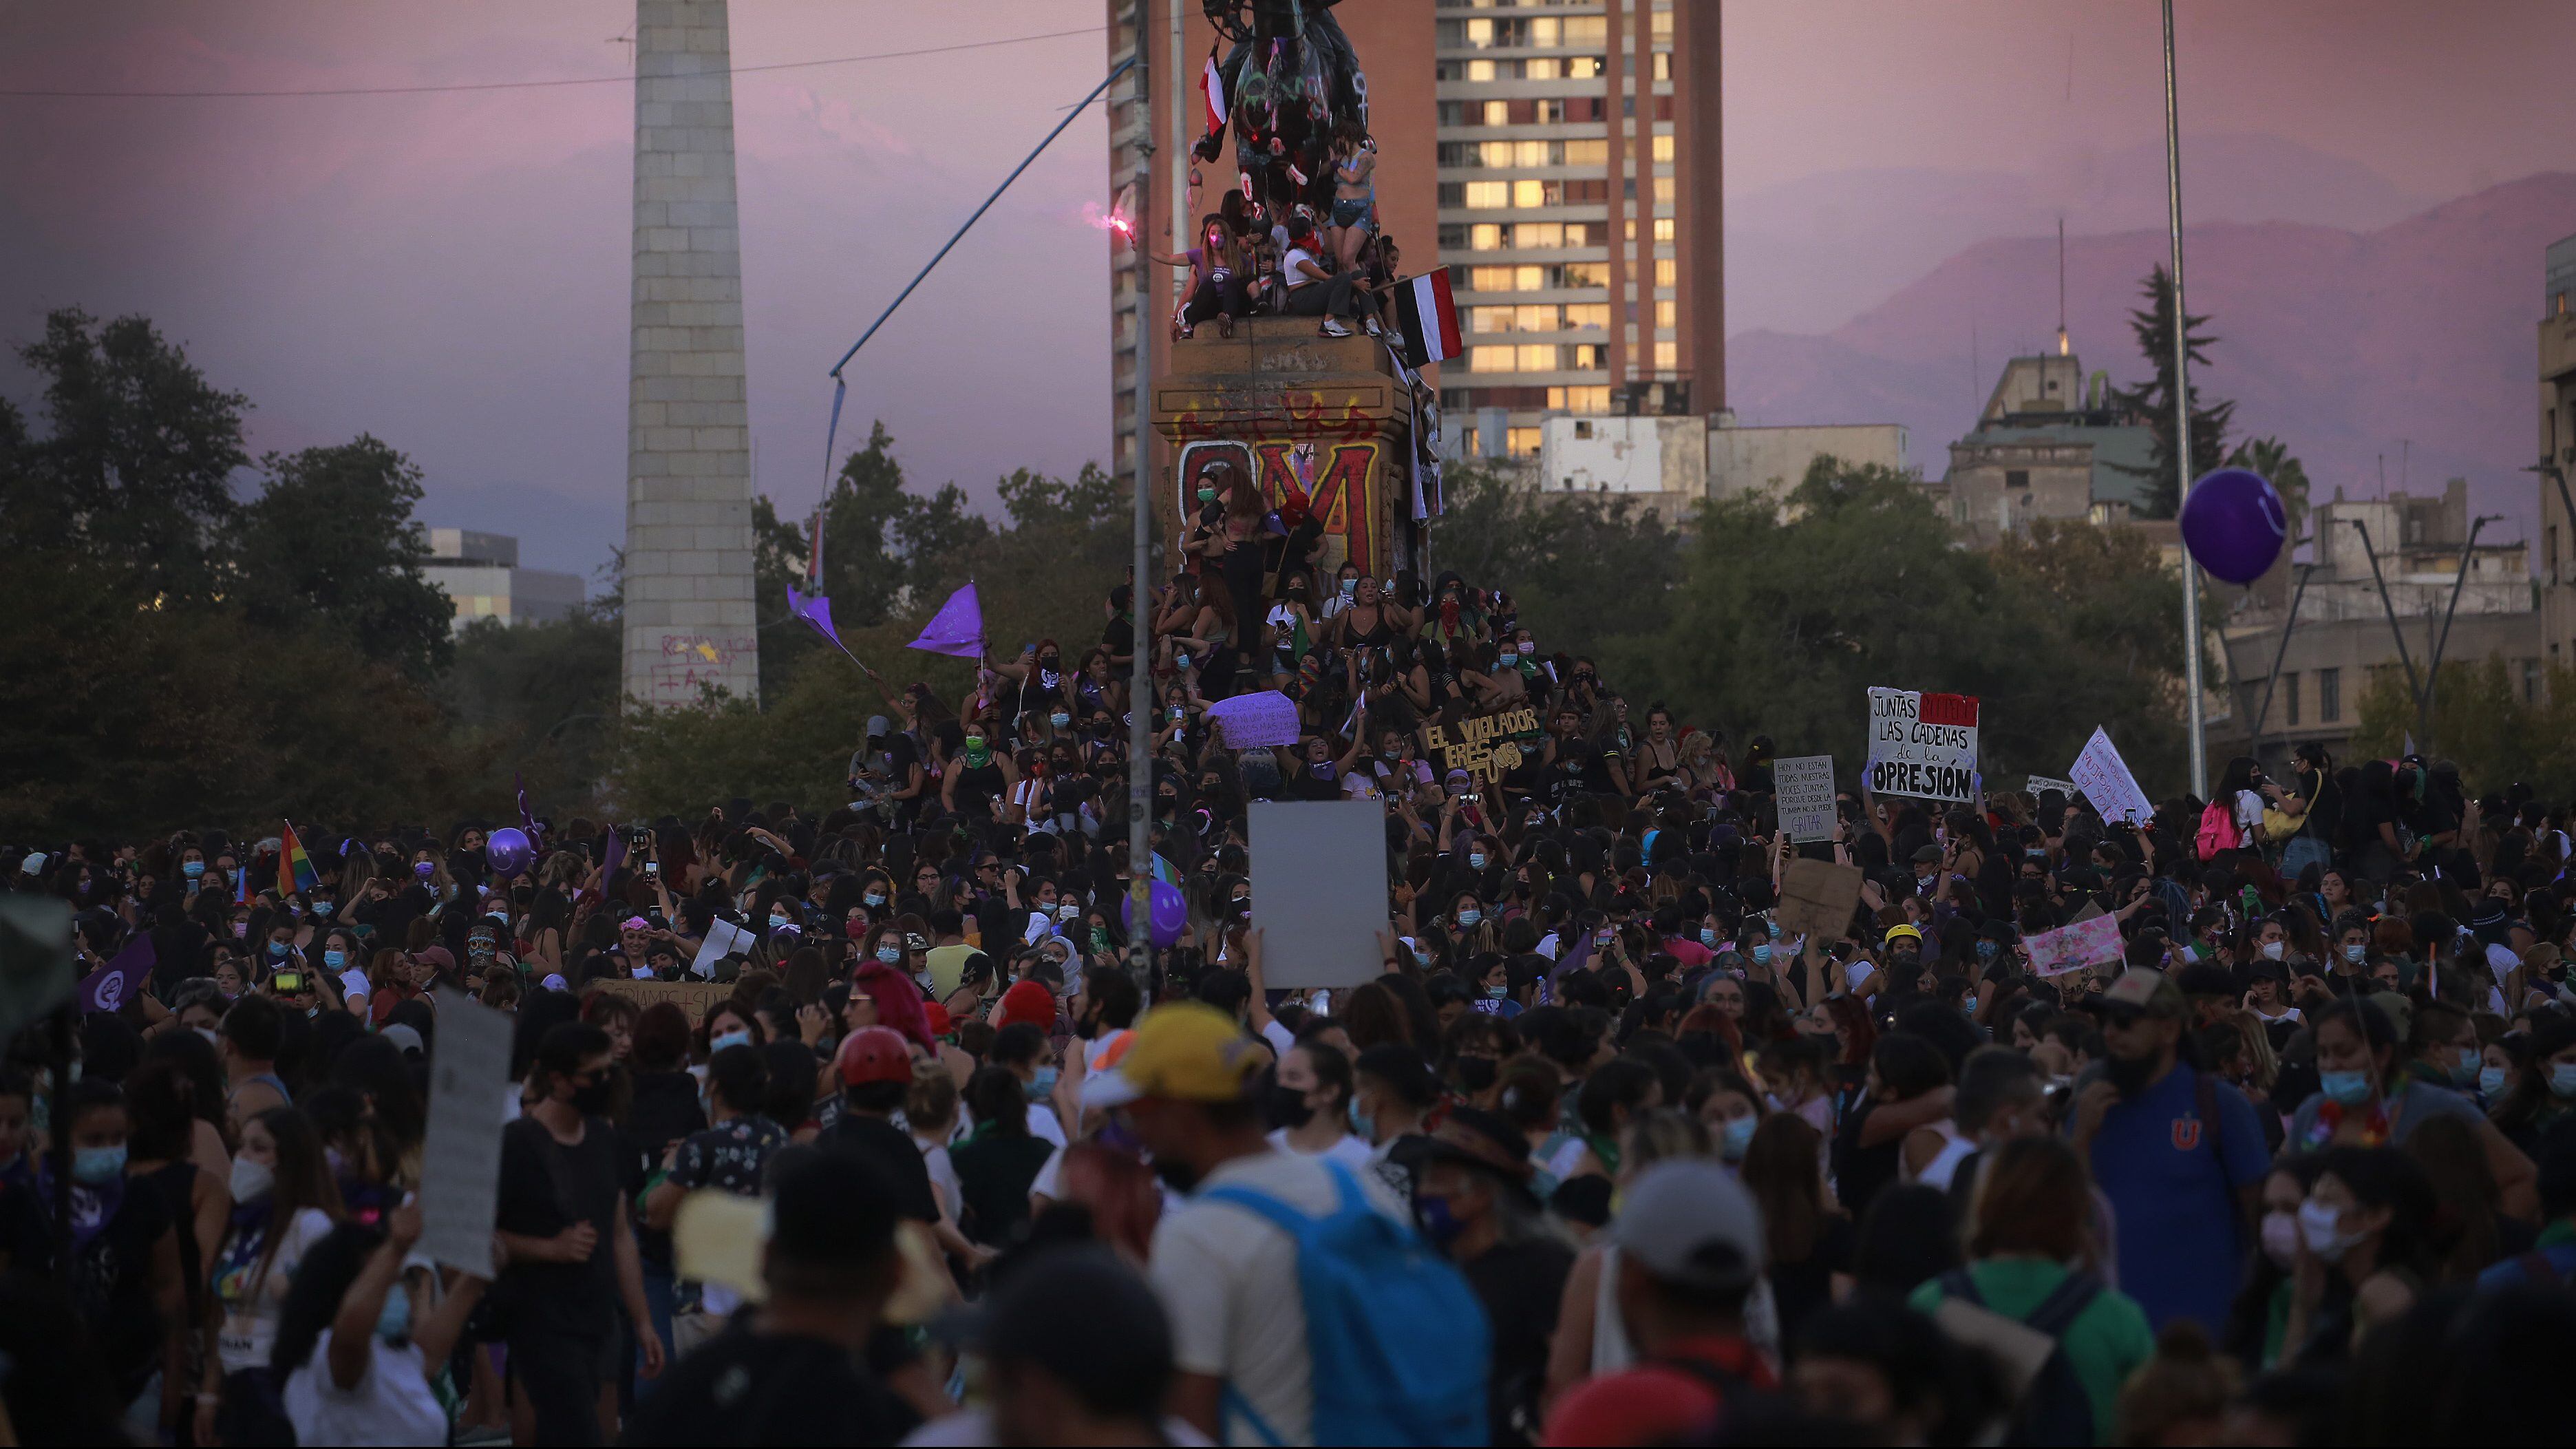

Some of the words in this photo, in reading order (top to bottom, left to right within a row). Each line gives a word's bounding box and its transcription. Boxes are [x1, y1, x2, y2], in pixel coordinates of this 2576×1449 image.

[1874, 695, 1917, 719] JUNTAS
[1426, 726, 1449, 750] EL
[1458, 708, 1540, 743] VIOLADOR
[1880, 721, 1904, 742] LAS
[1910, 722, 1968, 749] CADENAS
[1445, 739, 1493, 769] ERES
[1893, 744, 1915, 760] de
[1921, 746, 1945, 763] la
[1467, 761, 1498, 784] TU
[1778, 763, 1791, 772] HOY
[1808, 759, 1827, 770] ESTÁN
[1778, 773, 1798, 783] TODAS
[1801, 772, 1830, 783] NUESTRAS
[1873, 759, 1972, 799] OPRESIÓN
[2074, 766, 2093, 788] HOY
[1780, 785, 1801, 795] VOCES
[1802, 783, 1829, 793] JUNTAS
[1781, 795, 1806, 805] PORQUE
[1807, 794, 1822, 803] DESDE
[1781, 807, 1801, 815] TUMBA
[1791, 815, 1823, 835] GRITAR
[2171, 1118, 2202, 1151] U
